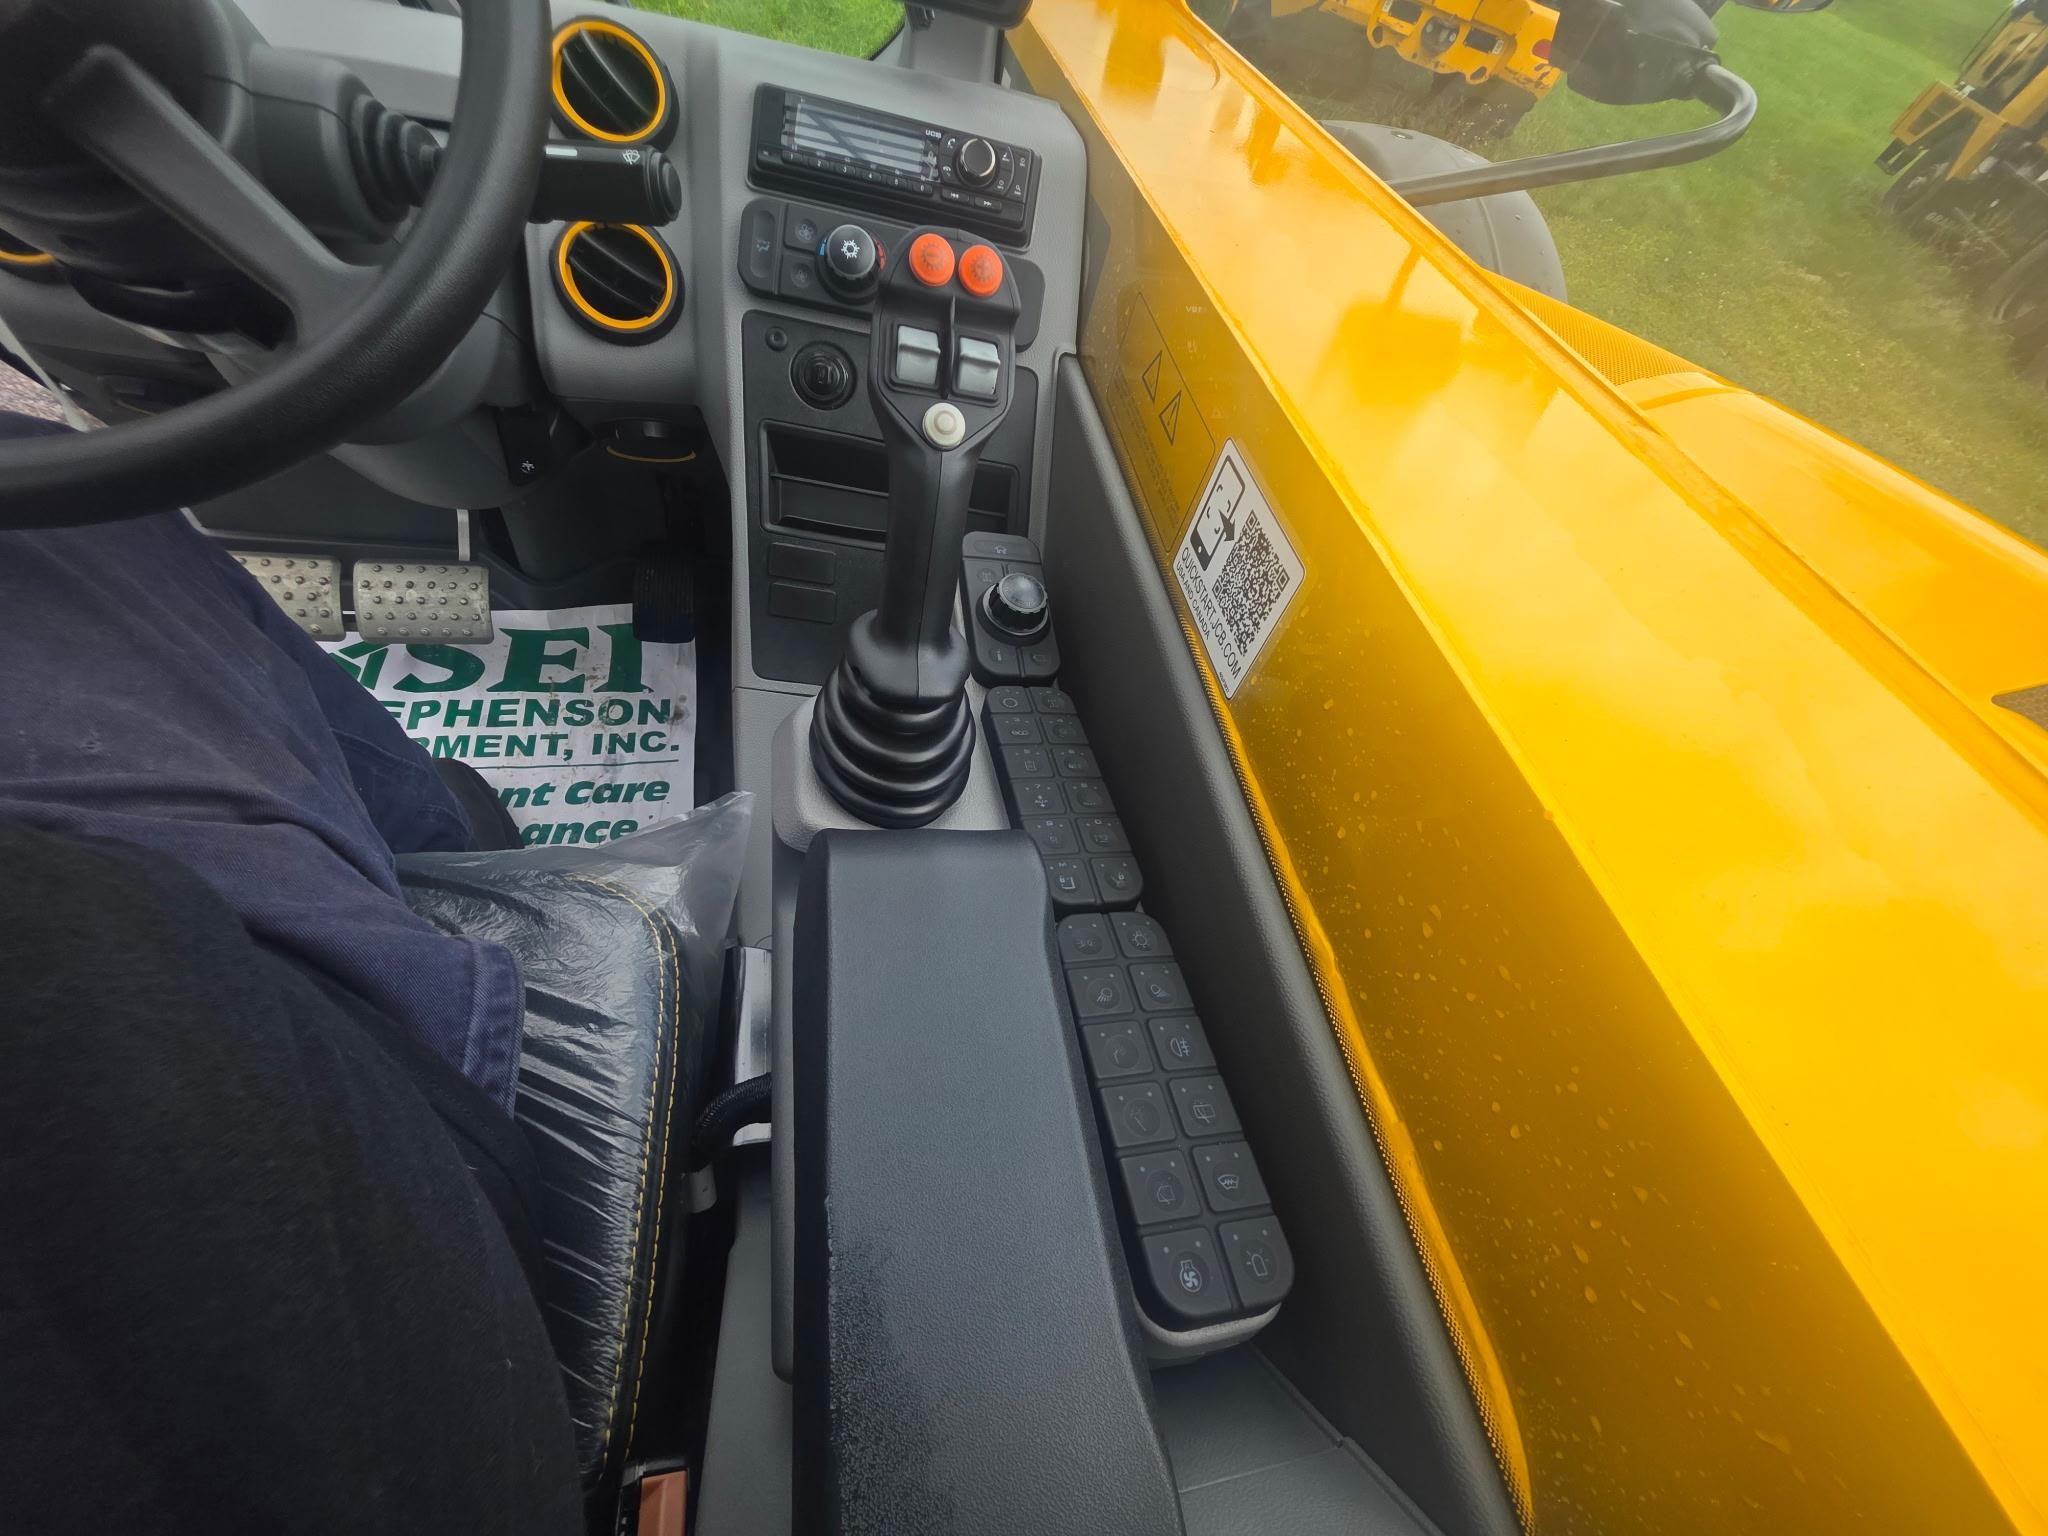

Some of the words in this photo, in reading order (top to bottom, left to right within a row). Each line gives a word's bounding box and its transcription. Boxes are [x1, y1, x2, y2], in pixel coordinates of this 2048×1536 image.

[1176, 561, 1186, 580] USA
[1184, 578, 1194, 600] AND
[1191, 599, 1211, 640] CANADA
[1181, 546, 1242, 680] QUICKSTART.JCB.COM
[412, 734, 573, 762] MENT,
[592, 731, 680, 756] INC.
[564, 780, 670, 806] Care
